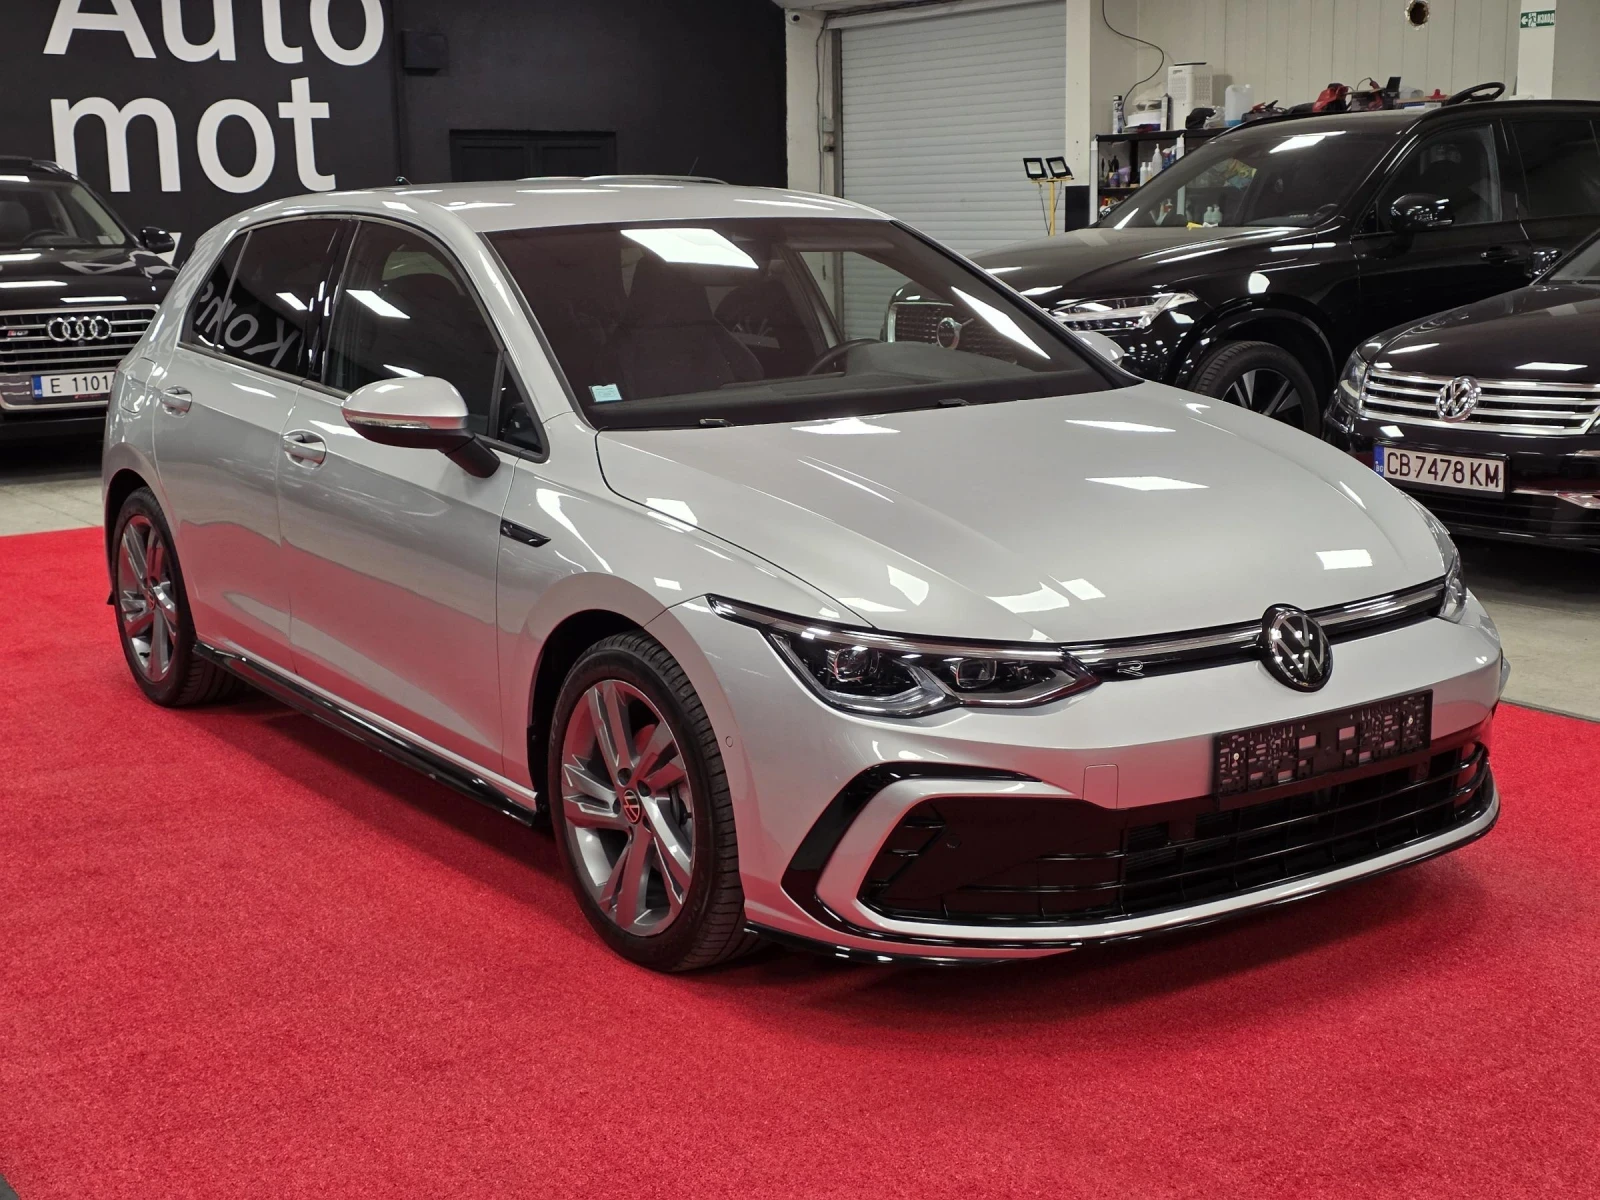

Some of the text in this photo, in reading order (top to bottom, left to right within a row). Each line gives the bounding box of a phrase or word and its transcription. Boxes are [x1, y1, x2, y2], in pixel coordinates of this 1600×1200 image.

[51, 77, 337, 194] mot
[50, 375, 109, 394] E 1101
[1415, 456, 1465, 484] 7478
[1470, 462, 1500, 488] KM
